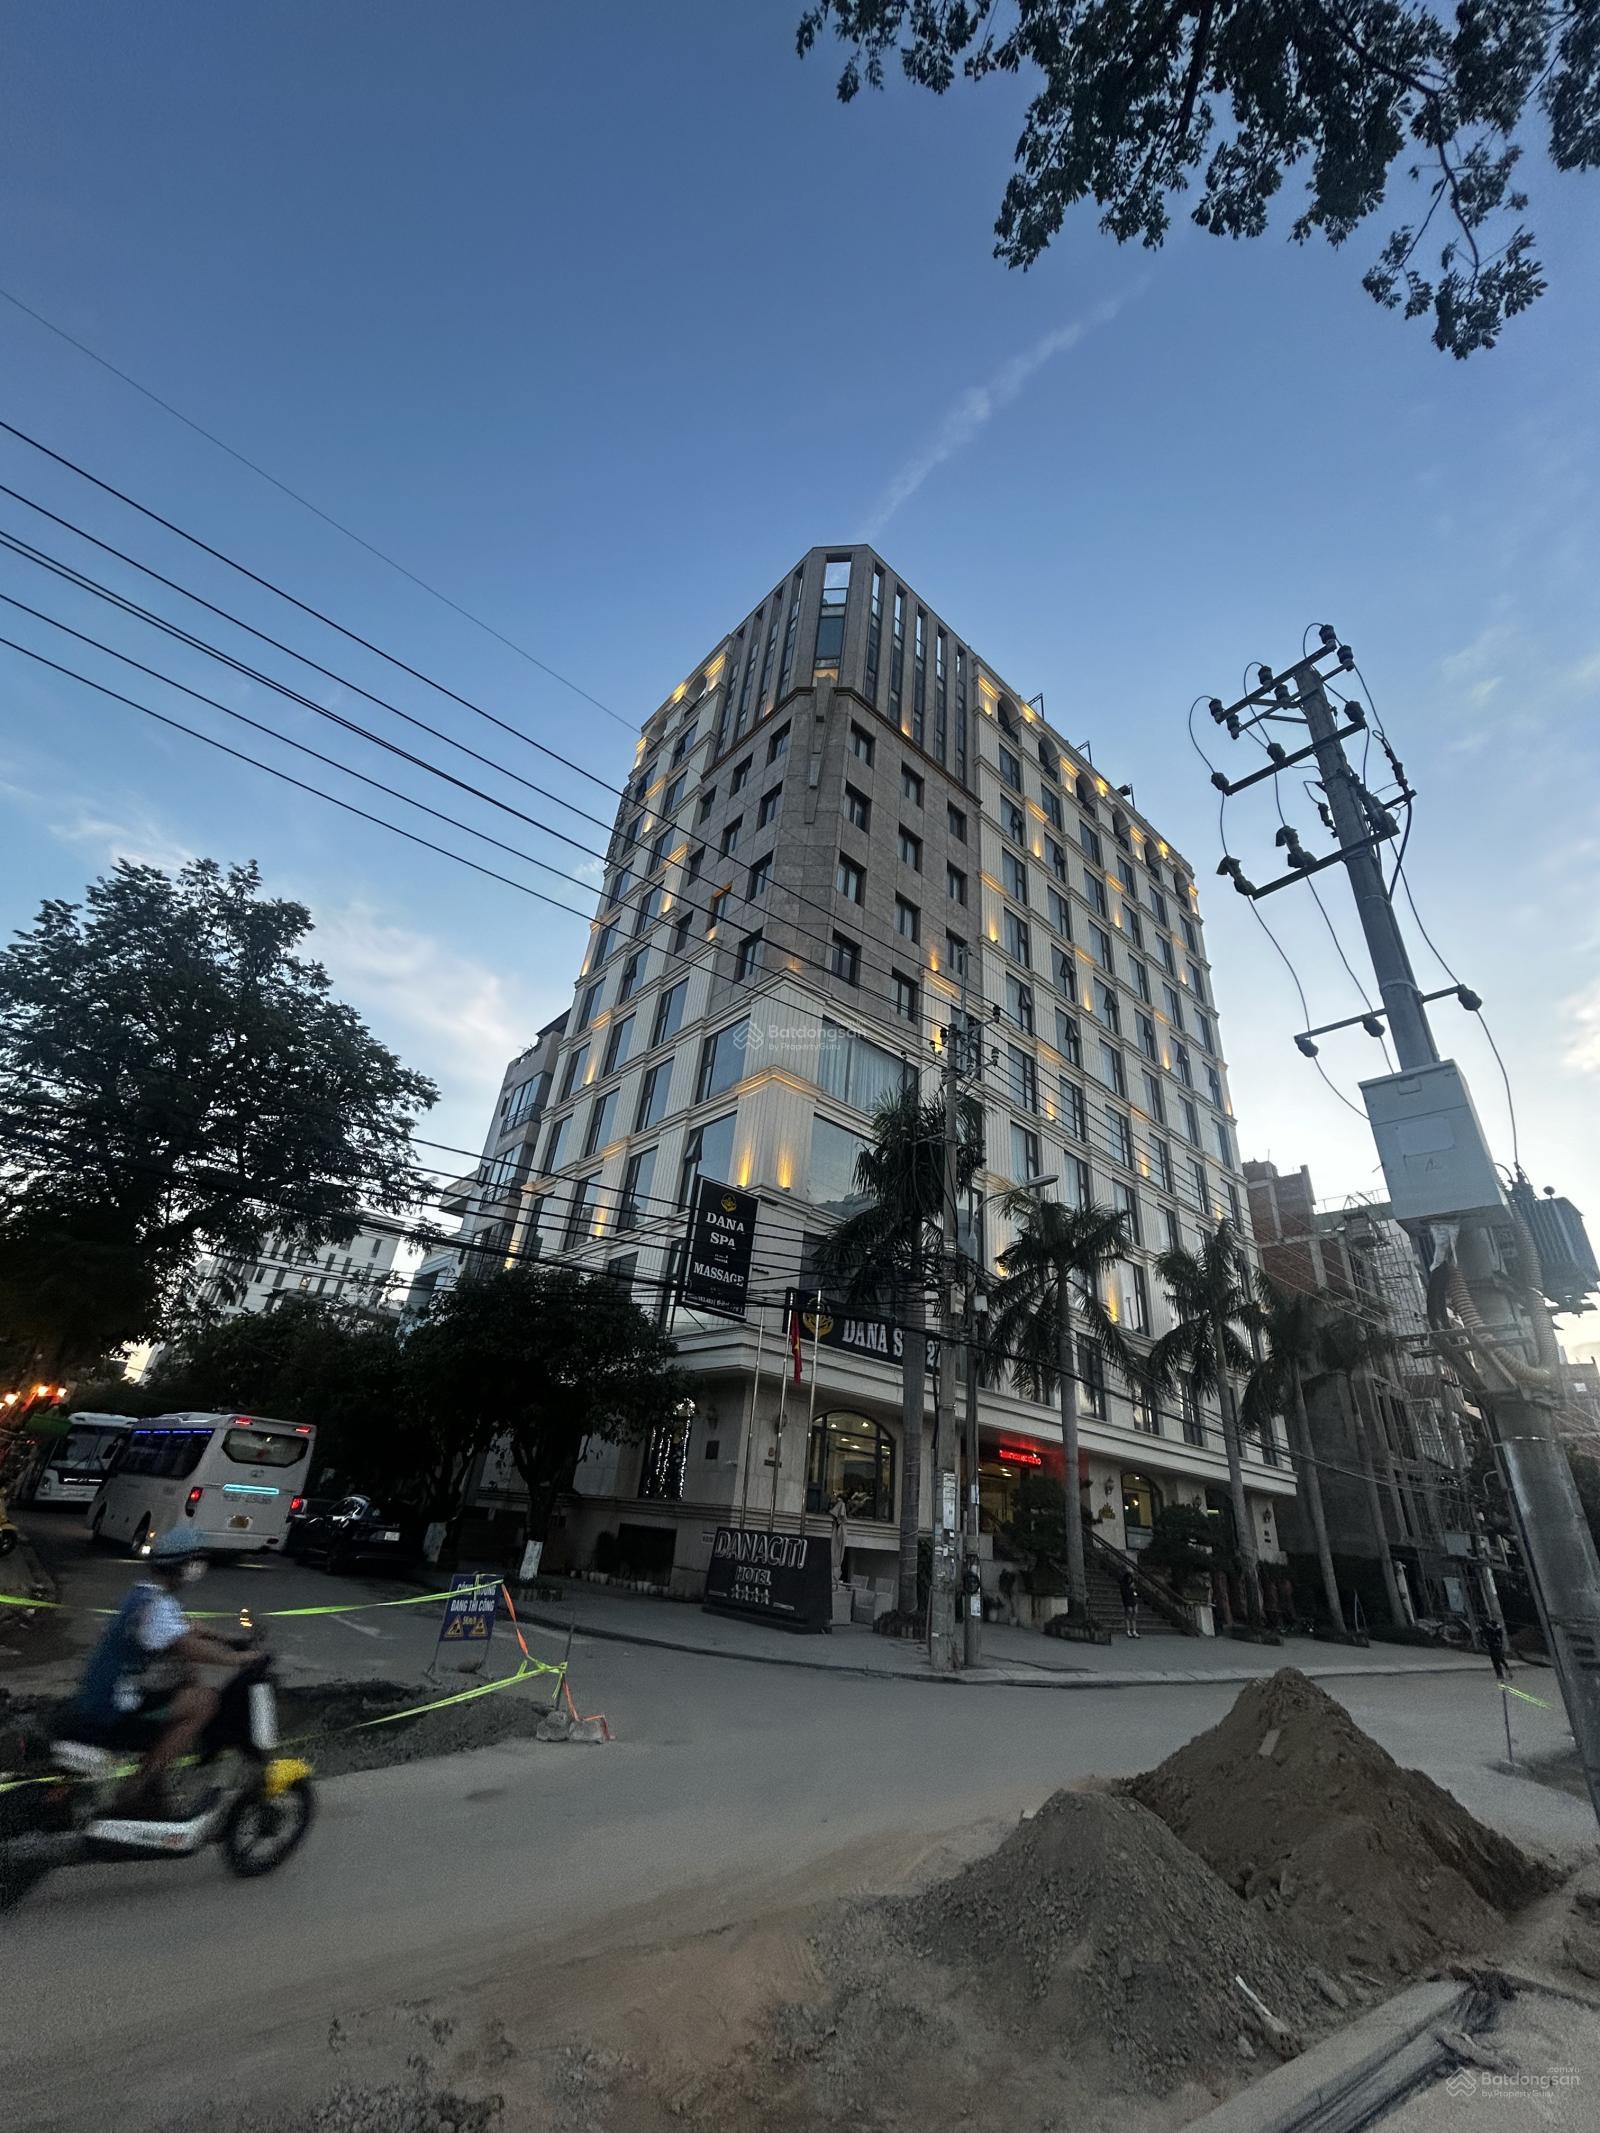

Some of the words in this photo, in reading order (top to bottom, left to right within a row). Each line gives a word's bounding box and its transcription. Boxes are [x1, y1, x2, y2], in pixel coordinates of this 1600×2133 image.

[705, 1211, 745, 1235] DANA
[709, 1231, 737, 1251] SPA
[693, 1261, 745, 1287] MASSAGE
[841, 1319, 888, 1354] DANA
[714, 1530, 808, 1570] DANACITI
[735, 1565, 772, 1586] HOTEL
[478, 1597, 496, 1612] CÔNG
